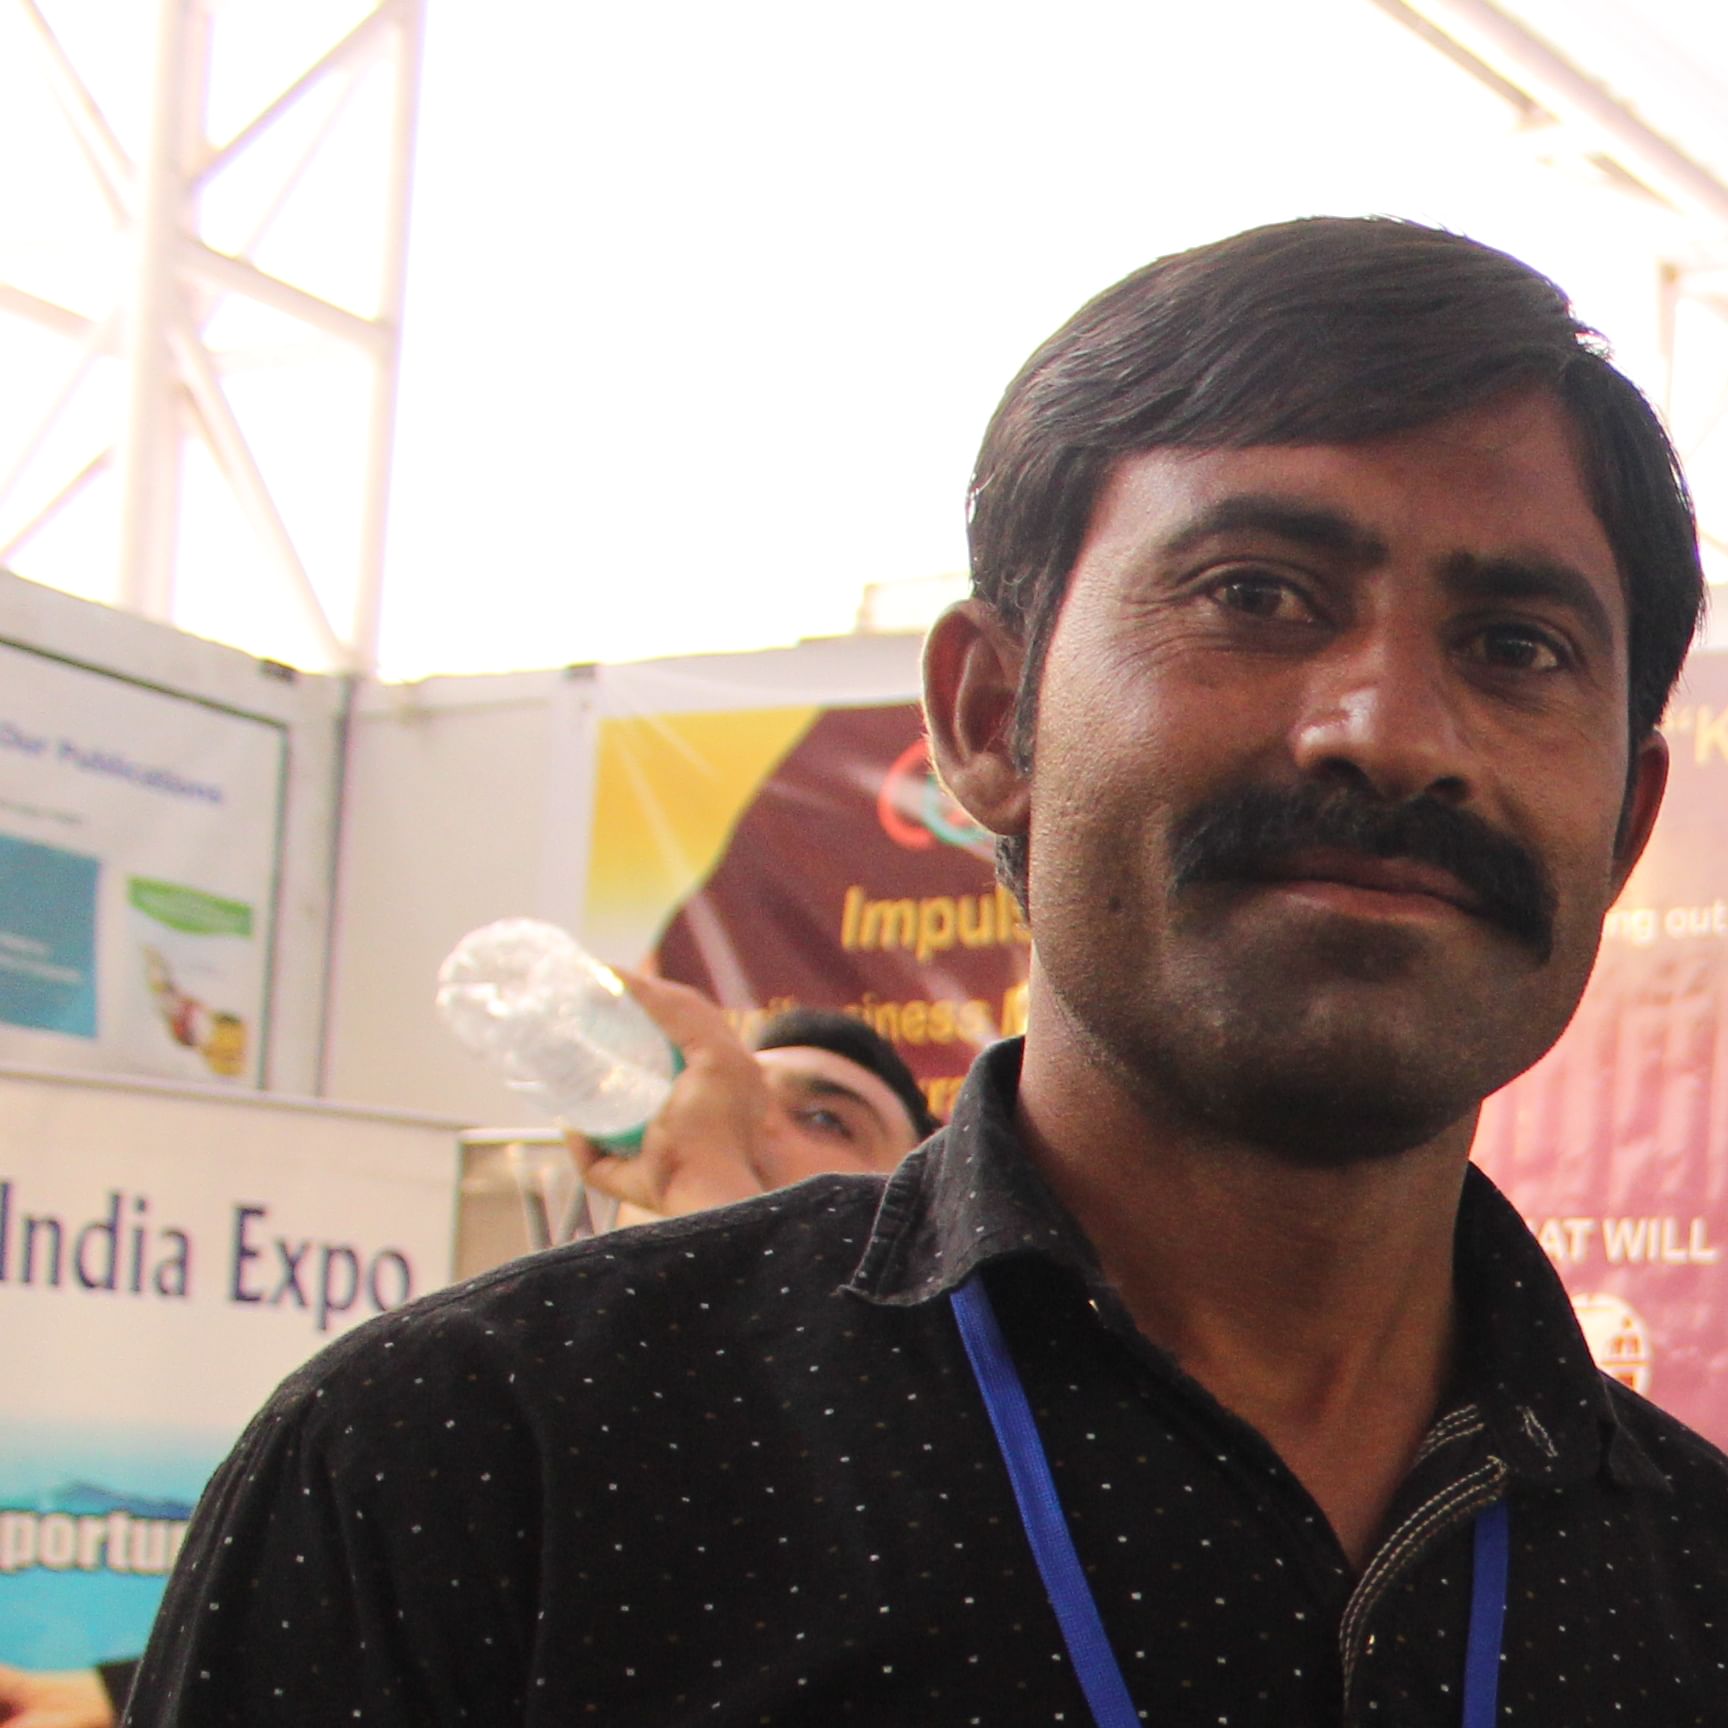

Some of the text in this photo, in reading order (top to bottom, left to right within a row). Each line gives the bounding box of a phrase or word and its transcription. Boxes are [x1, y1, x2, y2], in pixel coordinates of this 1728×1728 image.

[1664, 901, 1728, 938] out
[0, 1178, 412, 1331] India Expo
[1523, 1216, 1597, 1263] AT
[1601, 1215, 1717, 1263] WILL
